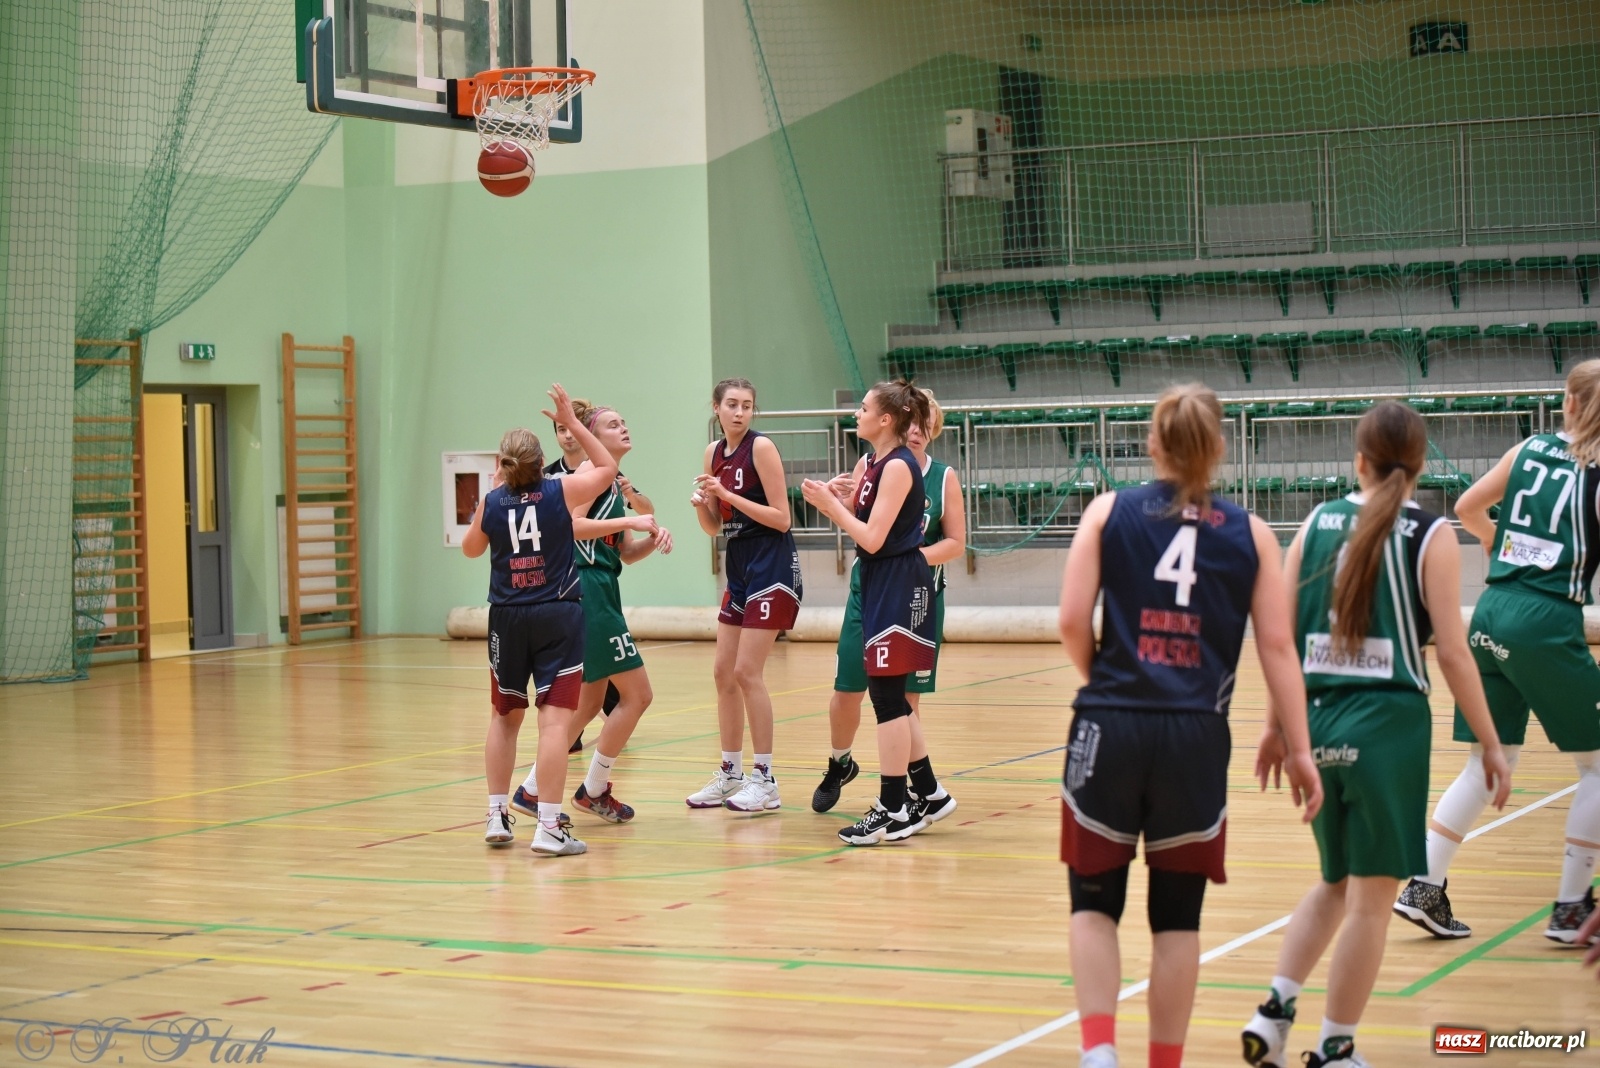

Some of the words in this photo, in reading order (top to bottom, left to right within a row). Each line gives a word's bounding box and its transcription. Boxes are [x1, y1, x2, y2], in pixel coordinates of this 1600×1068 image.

[1437, 32, 1461, 49] A
[734, 468, 744, 490] 9
[1509, 458, 1577, 534] 27
[508, 505, 542, 554] 14
[1317, 512, 1347, 531] RKK
[1154, 525, 1198, 607] 4
[511, 570, 547, 589] POLSKA
[760, 601, 770, 620] 9
[609, 632, 637, 662] 35
[876, 646, 889, 668] 12
